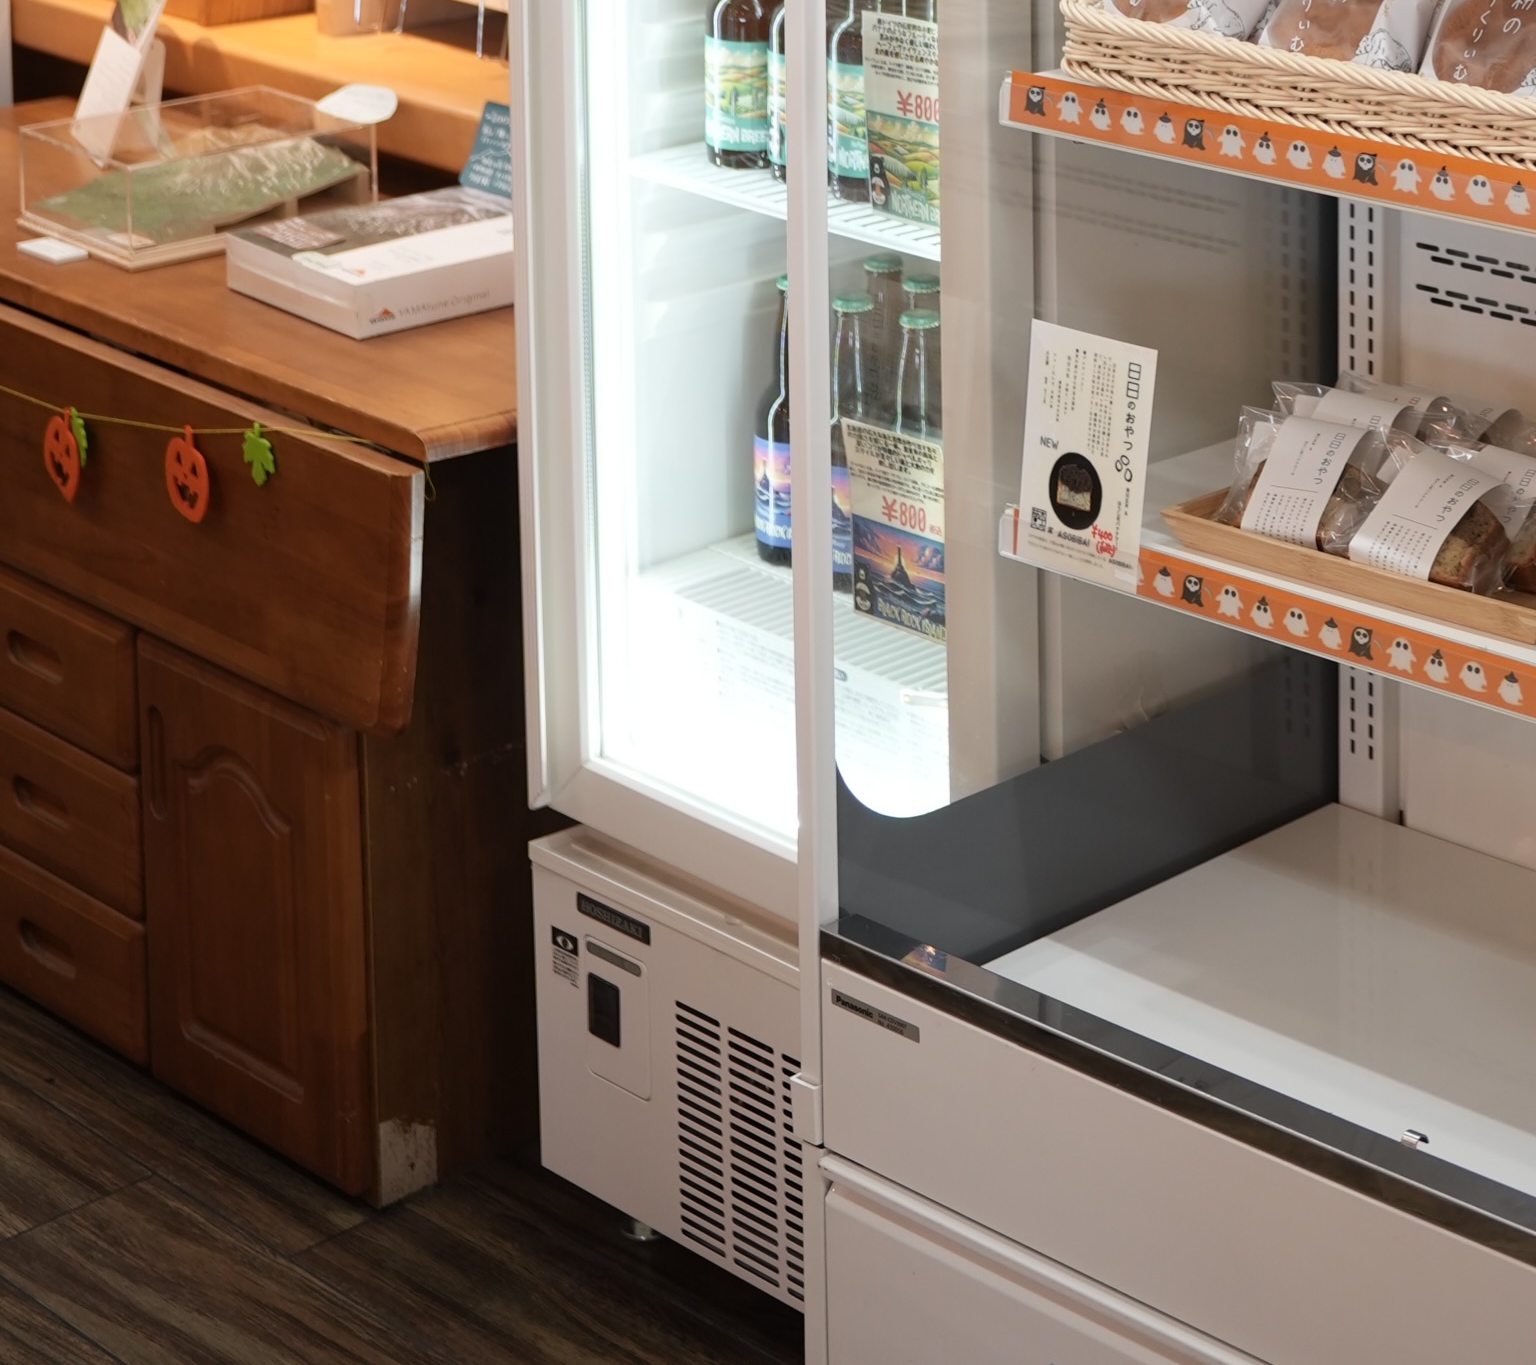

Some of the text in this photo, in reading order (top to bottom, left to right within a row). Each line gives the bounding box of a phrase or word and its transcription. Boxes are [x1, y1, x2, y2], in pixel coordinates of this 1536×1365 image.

[1040, 435, 1059, 451] NEW
[882, 495, 926, 532] ¥800
[580, 898, 644, 938] HOSHIZAKI
[836, 995, 874, 1020] Panasonic
